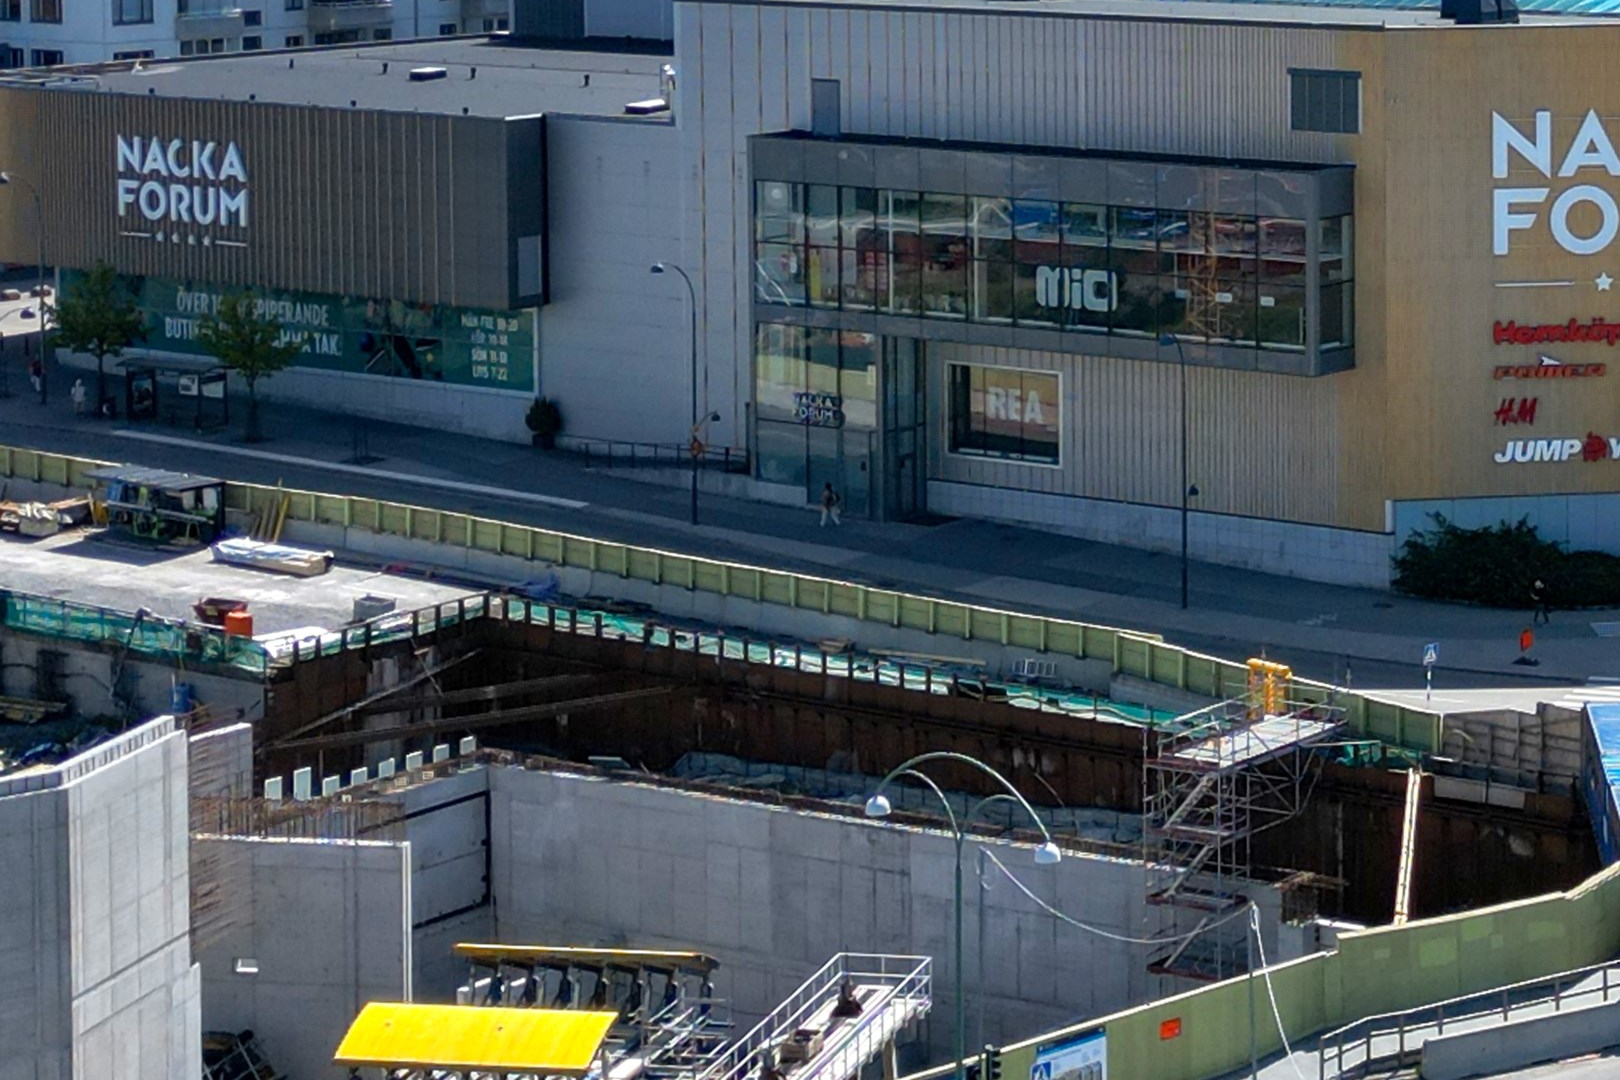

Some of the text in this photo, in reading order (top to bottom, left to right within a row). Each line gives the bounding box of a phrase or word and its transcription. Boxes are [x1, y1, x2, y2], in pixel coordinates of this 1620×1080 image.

[117, 134, 248, 182] NACKA
[118, 179, 248, 227] FORUM
[176, 286, 209, 314] ÖVER
[236, 297, 329, 328] SPIRERANDE
[988, 386, 1044, 424] REA
[1494, 438, 1582, 463] JUMP
